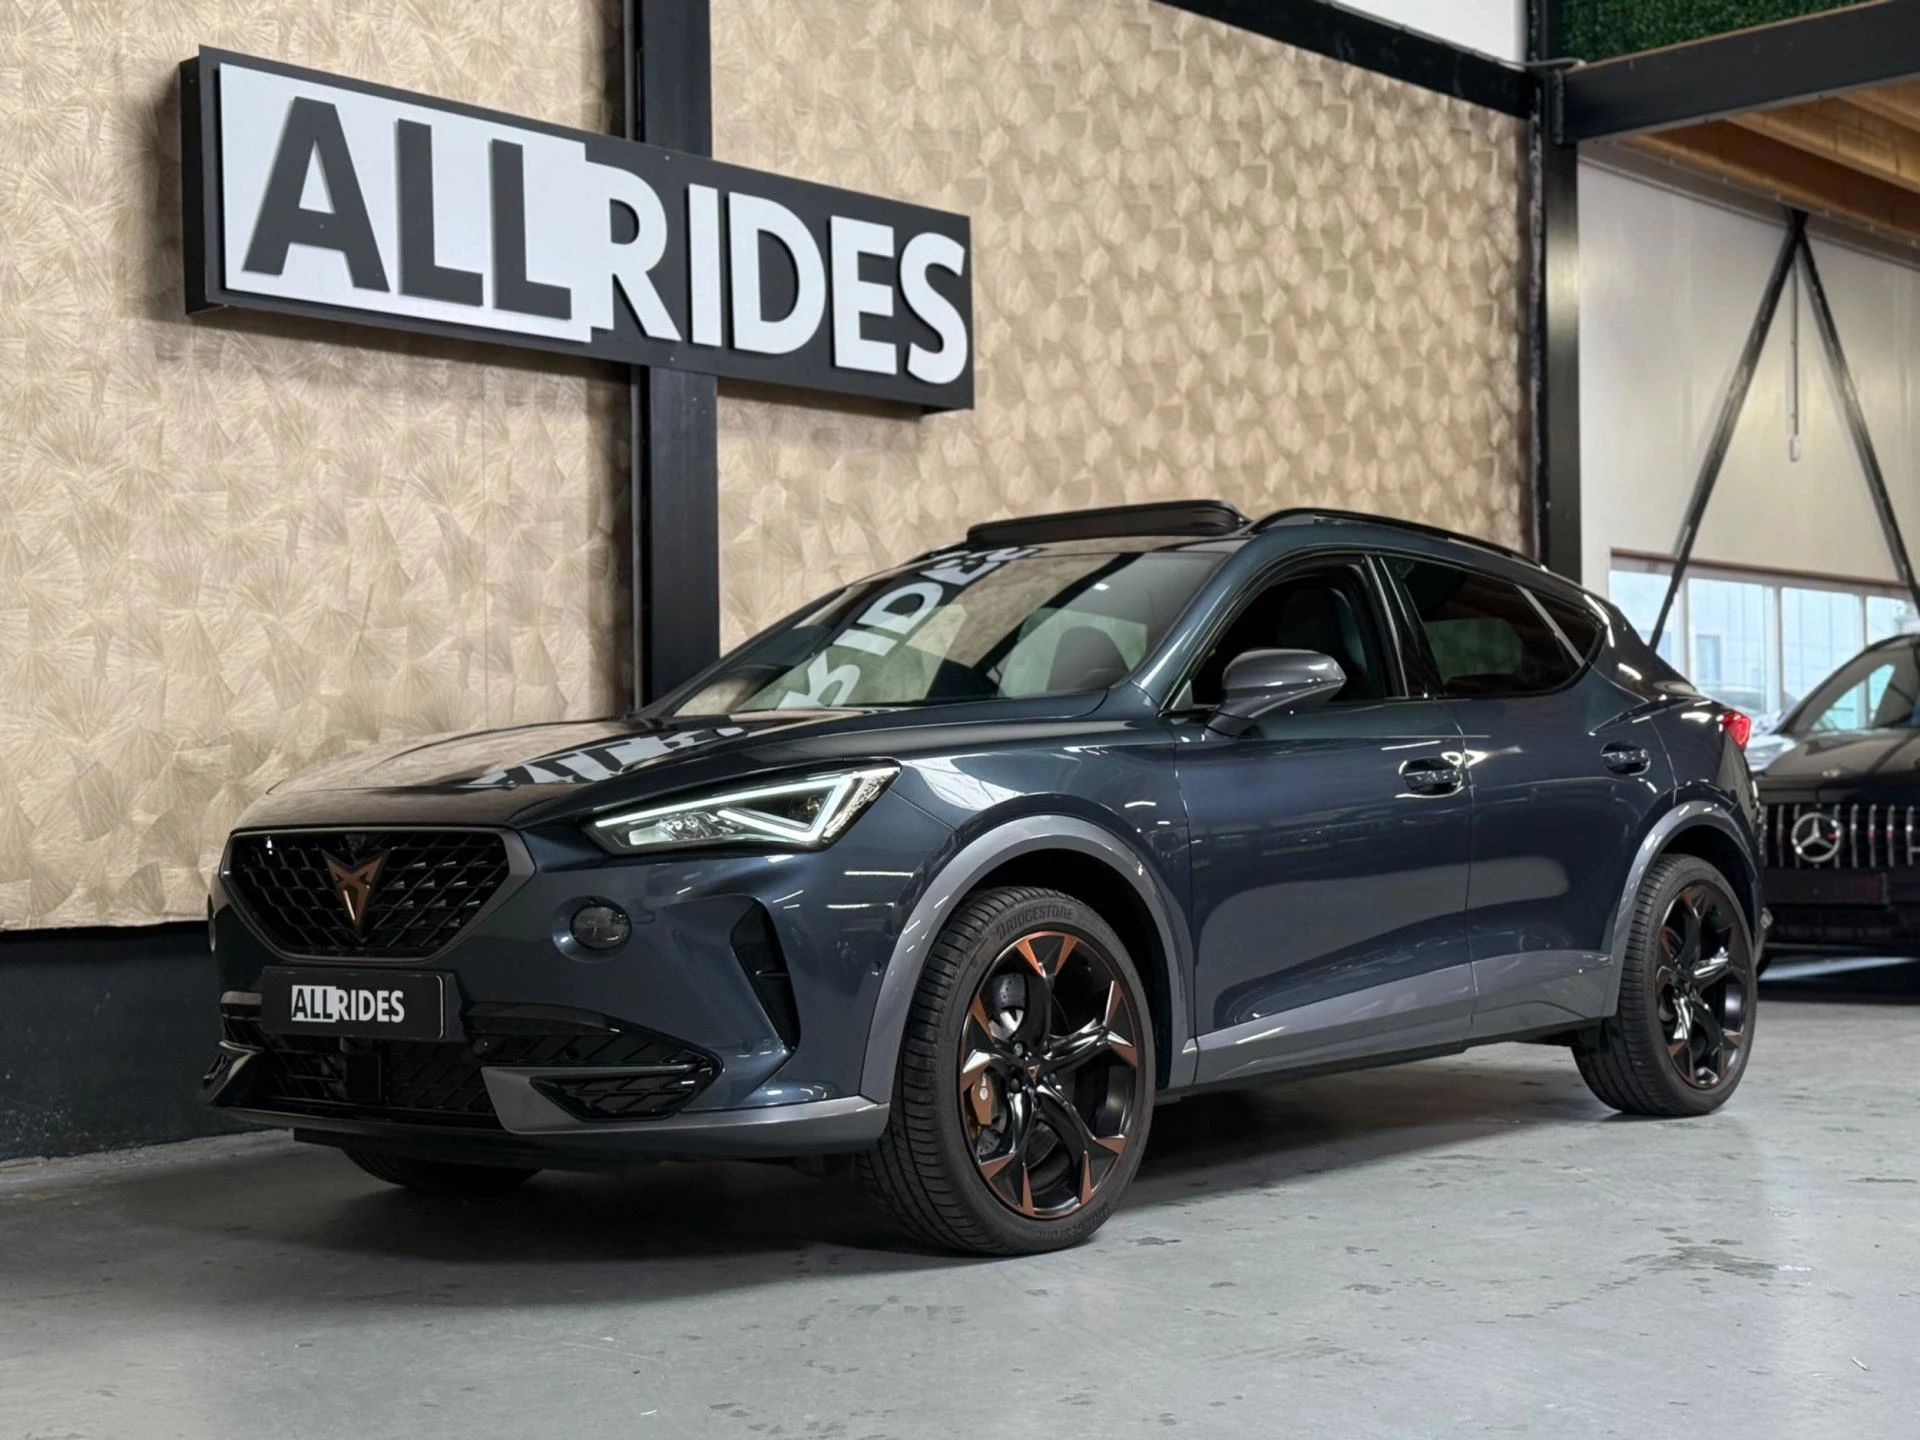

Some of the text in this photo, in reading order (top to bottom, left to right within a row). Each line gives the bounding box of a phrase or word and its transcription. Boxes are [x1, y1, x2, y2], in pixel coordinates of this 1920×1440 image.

[241, 95, 968, 384] ALLRIDES
[996, 904, 1074, 937] BRIDGESTONE
[292, 987, 405, 1023] ALLRIDES
